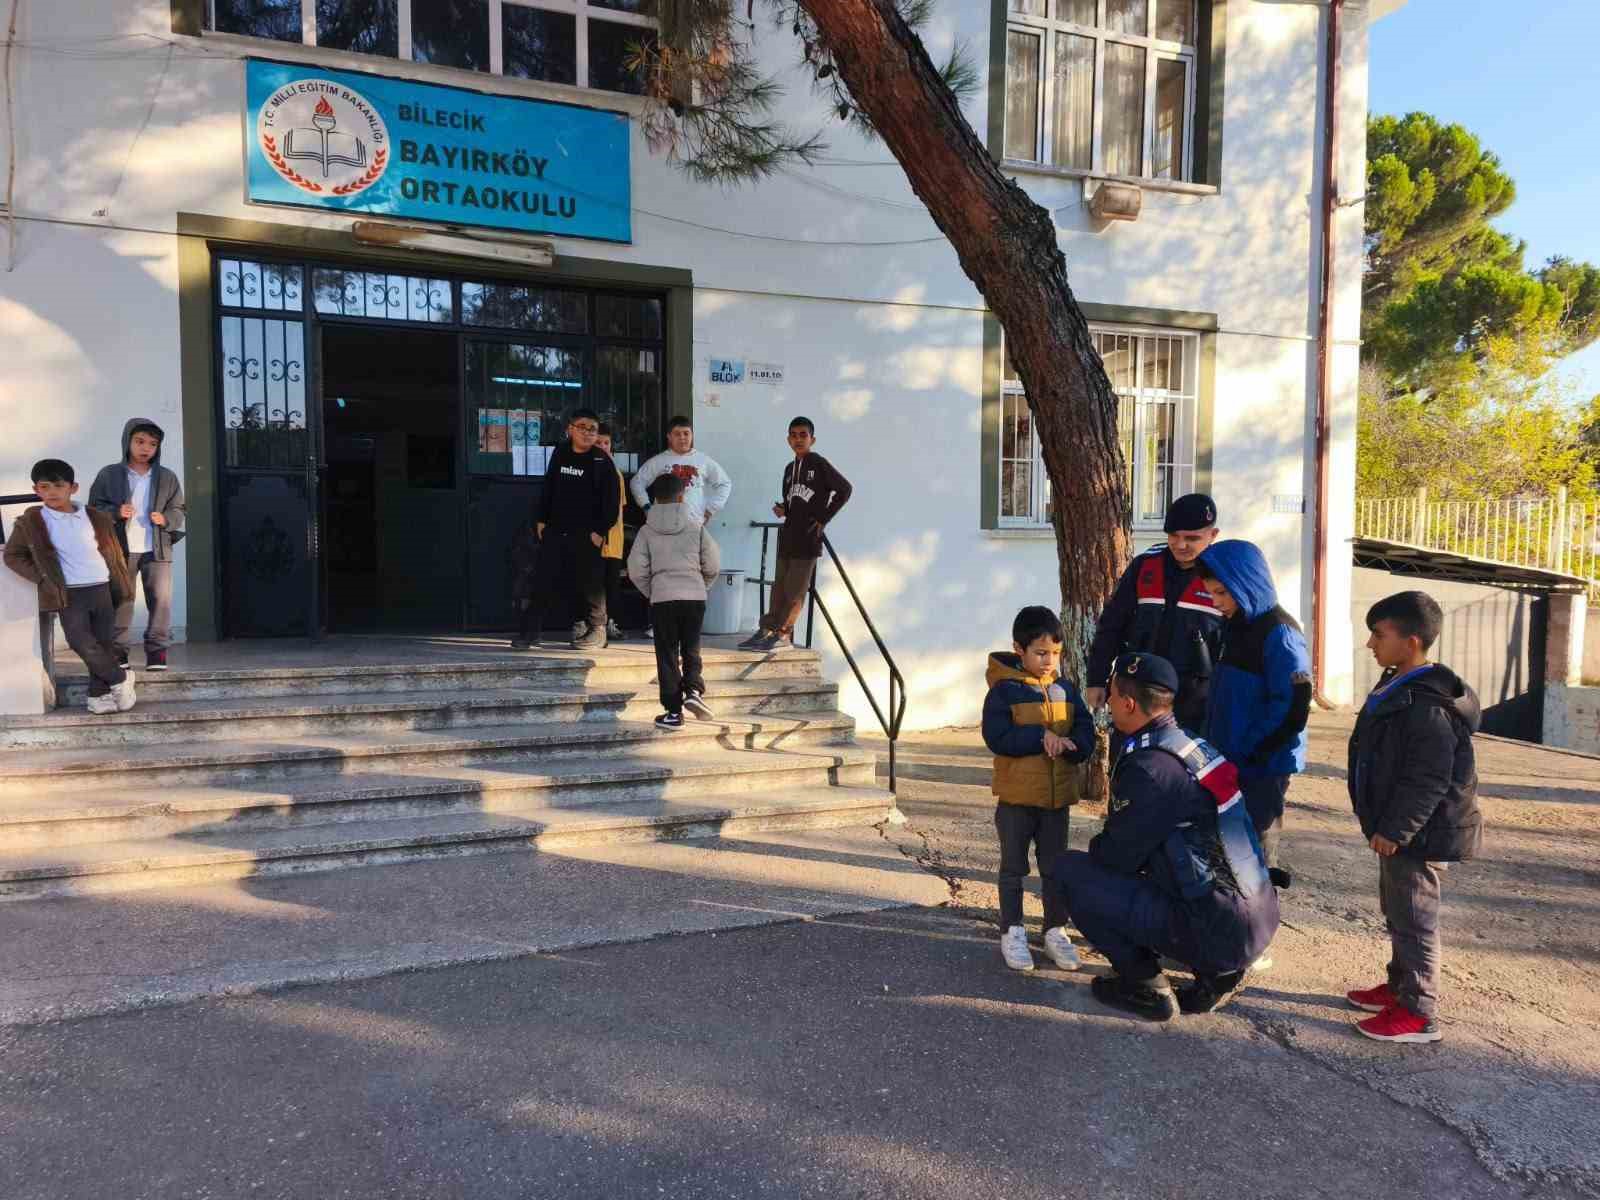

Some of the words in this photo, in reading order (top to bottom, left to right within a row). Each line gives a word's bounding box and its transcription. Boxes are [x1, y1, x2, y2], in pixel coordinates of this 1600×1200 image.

[398, 102, 486, 133] BİLECİK
[400, 139, 549, 180] BAYIRKÖY
[400, 177, 577, 219] ORTAOKULU
[711, 371, 741, 384] BLOK
